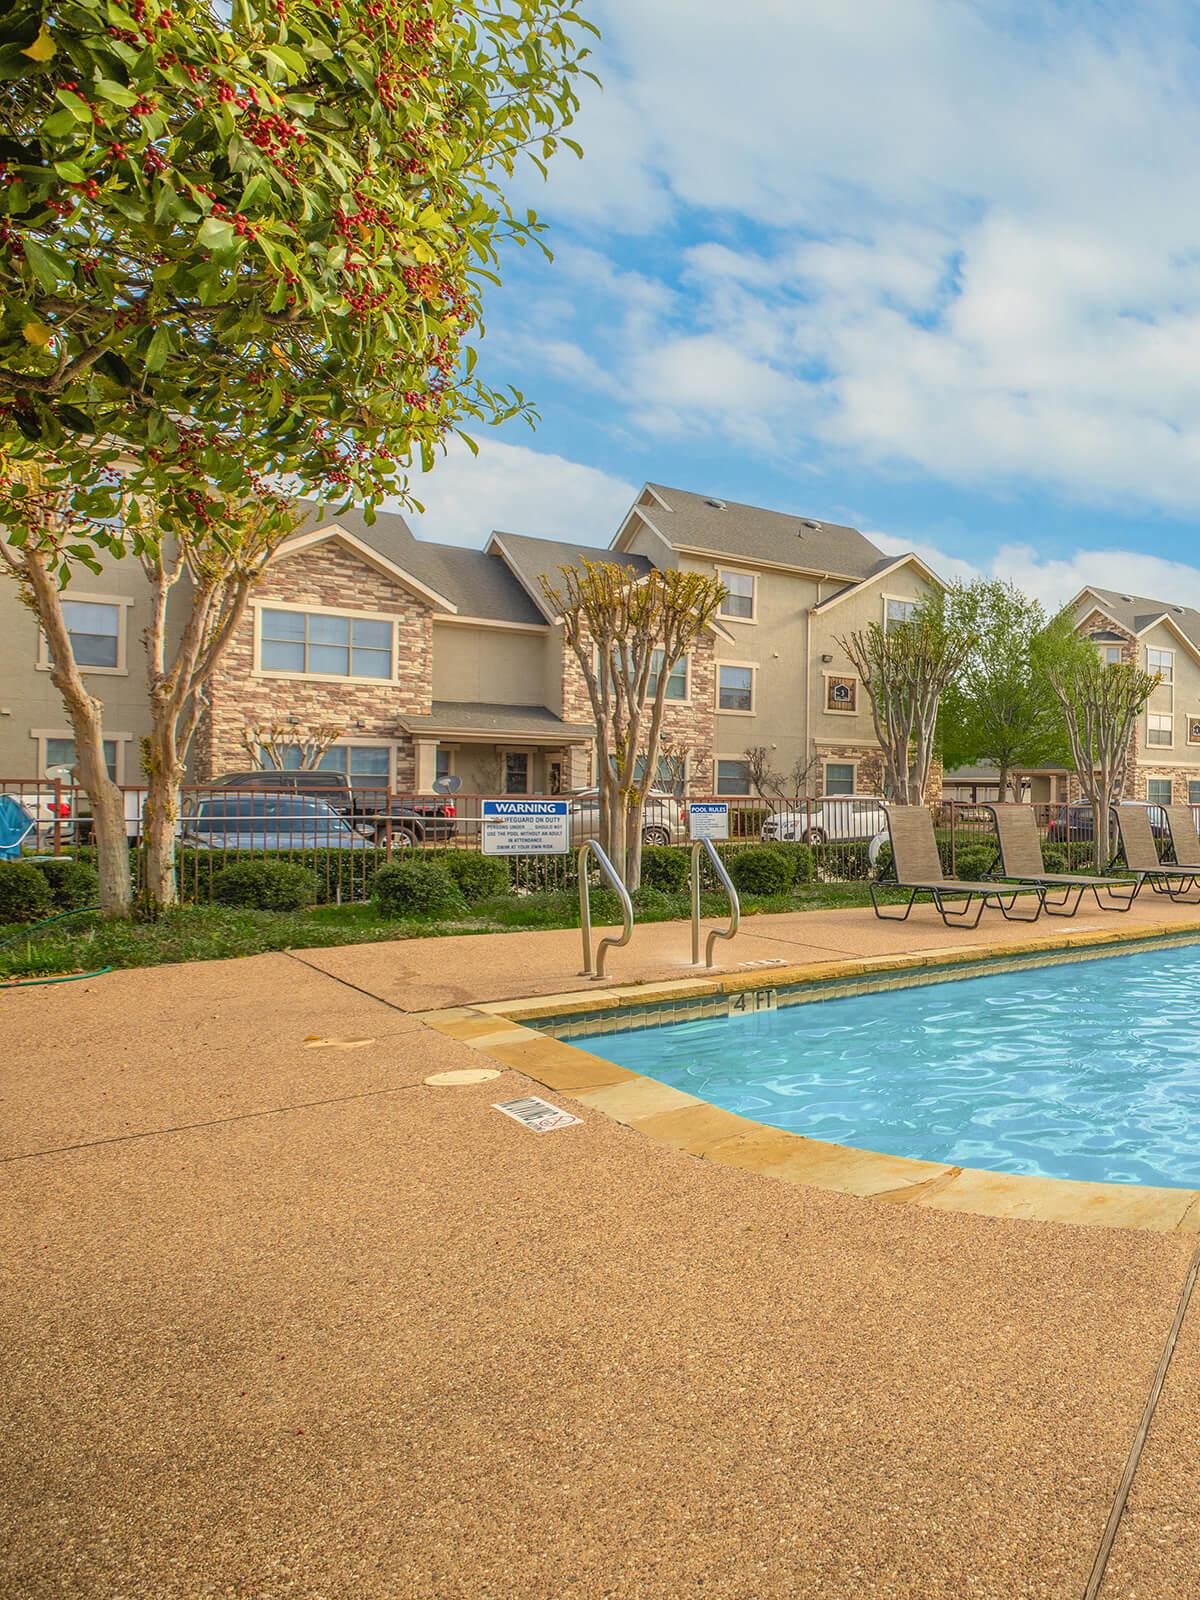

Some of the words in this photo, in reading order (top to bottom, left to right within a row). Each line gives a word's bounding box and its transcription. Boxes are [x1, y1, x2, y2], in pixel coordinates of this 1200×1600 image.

[495, 803, 556, 813] WARNING
[733, 993, 746, 1012] 4
[756, 990, 773, 1010] FT
